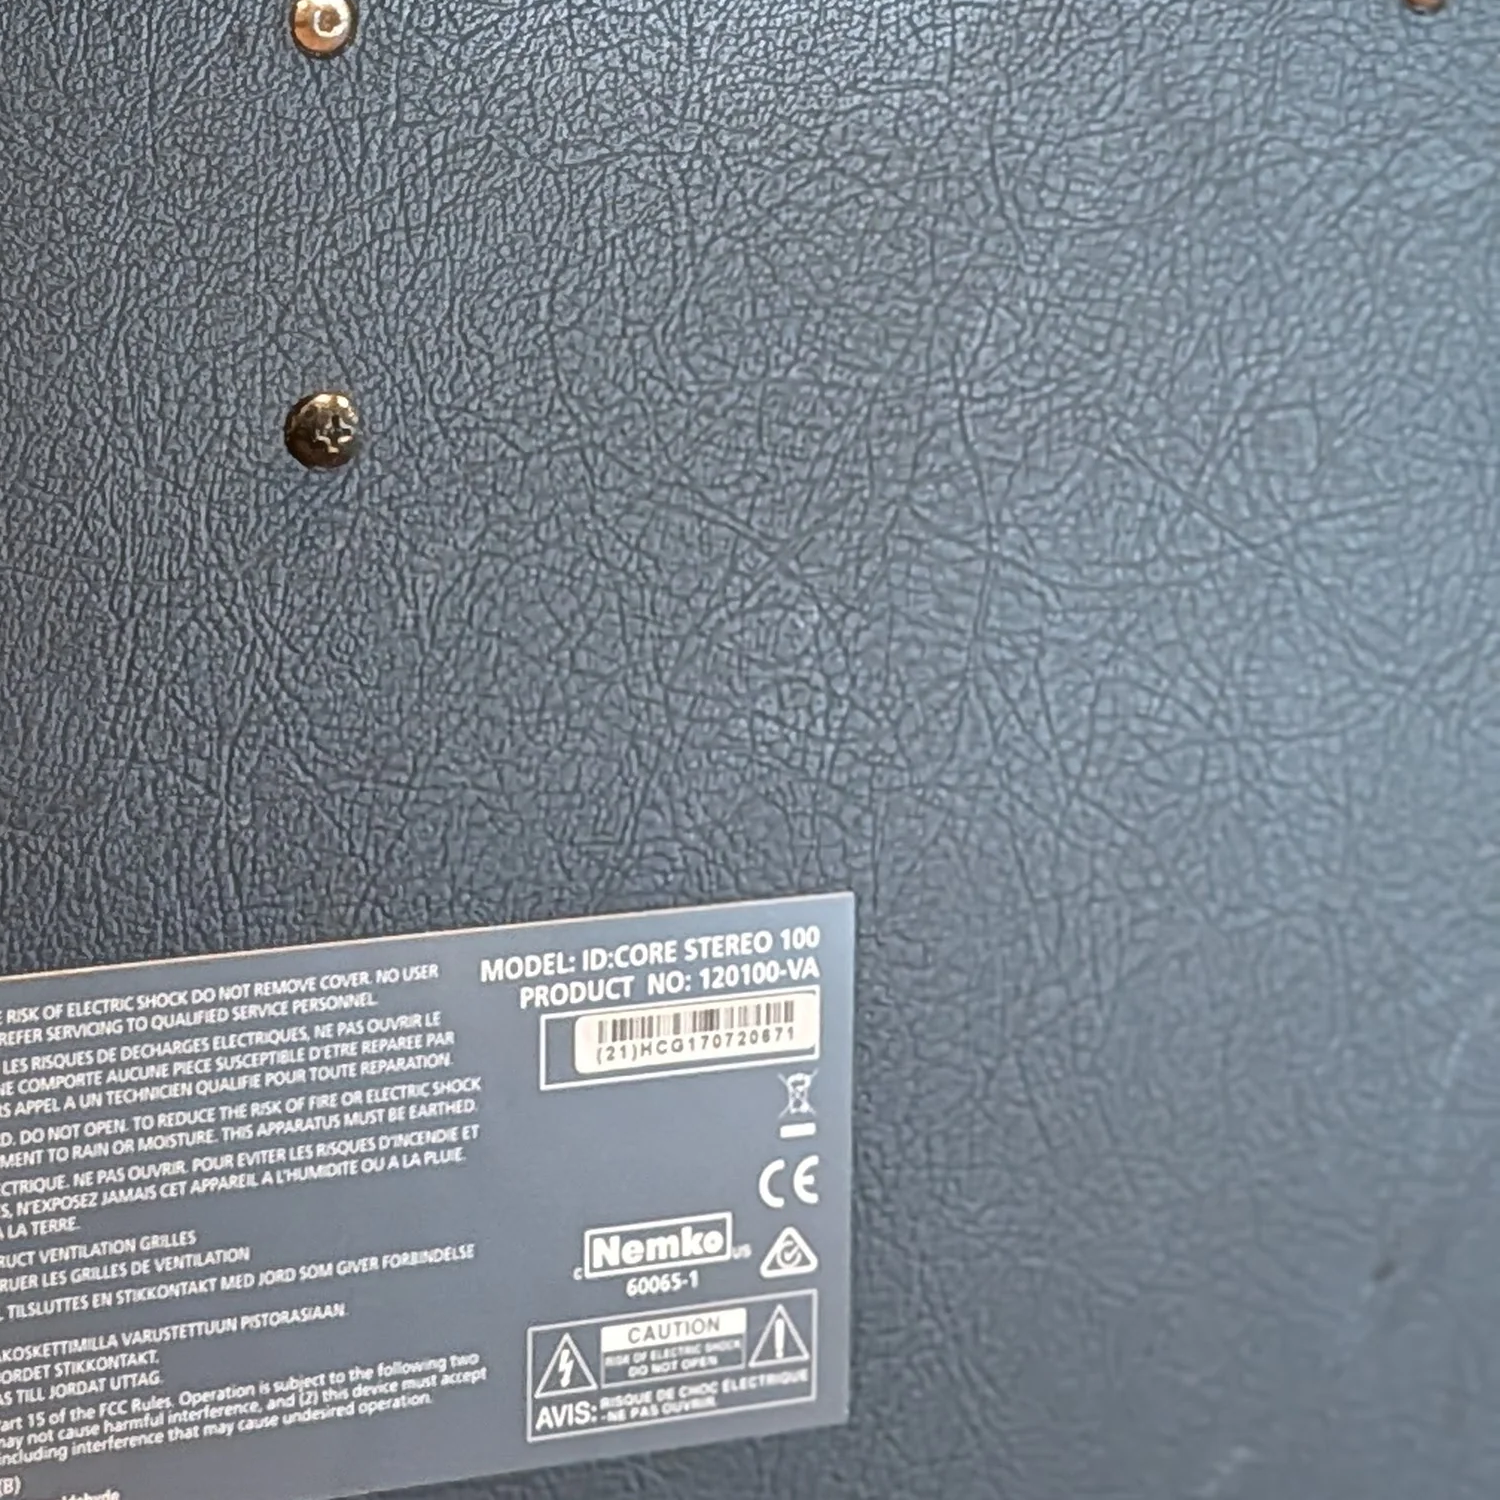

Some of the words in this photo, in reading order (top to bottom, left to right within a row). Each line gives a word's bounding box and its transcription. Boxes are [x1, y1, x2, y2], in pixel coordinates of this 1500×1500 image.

[480, 953, 576, 983] MODEL:
[582, 940, 677, 972] ID:CORE
[684, 931, 773, 961] STEREO
[781, 925, 820, 951] 100
[6, 1006, 39, 1023] RISK
[42, 1003, 63, 1020] OF
[67, 995, 134, 1017] ELECTRIC
[136, 990, 188, 1010] SHOCK
[191, 987, 216, 1004] DO
[218, 983, 250, 1000] NOT
[253, 976, 316, 996] REMOVE
[319, 971, 372, 990] COVER.
[375, 967, 399, 983] NO
[402, 963, 439, 981] USER
[519, 975, 635, 1009] PRODUCT
[647, 969, 692, 997] NO:
[700, 956, 820, 991] 120100-VA
[45, 1018, 123, 1042] SERVICING
[126, 1016, 147, 1032] TO
[150, 1007, 229, 1031] QUALIFIED
[232, 1000, 288, 1021] SERVICE
[292, 992, 378, 1014] PERSONNEL.
[19, 1127, 44, 1145] DO
[47, 1123, 81, 1140] NOT
[83, 1118, 129, 1137] OPEN.
[132, 1115, 154, 1131] TO
[157, 1107, 215, 1127] REDUCE
[218, 1103, 247, 1120] THE
[250, 1100, 281, 1117] RISK
[285, 1096, 305, 1113] OF
[308, 1092, 337, 1110] FIRE
[340, 1090, 363, 1106] OR
[366, 1082, 429, 1103] ELECTRIC
[432, 1076, 481, 1096] SHOCK
[47, 1146, 69, 1162] TO
[72, 1142, 109, 1160] RAIN
[111, 1138, 134, 1155] OR
[138, 1128, 218, 1151] MOISTURE.
[221, 1124, 253, 1141] THIS
[256, 1113, 340, 1137] APPARATUS
[343, 1108, 385, 1126] MUST
[387, 1105, 405, 1122] BE
[409, 1098, 477, 1119] EARTHED.
[7, 1223, 28, 1239] LA
[30, 1215, 81, 1235] TERRE.
[38, 1238, 135, 1264] VENTILATION
[139, 1229, 197, 1250] GRILLES
[591, 1226, 724, 1270] Nemko
[41, 1270, 67, 1287] LES
[70, 1262, 127, 1283] GRILLES
[130, 1258, 150, 1276] DE
[154, 1246, 250, 1272] VENTILATION
[625, 1269, 700, 1298] 60065-1
[627, 1316, 721, 1345] CAUTION
[16, 1387, 45, 1404] TILL
[48, 1377, 106, 1399] JORDAT
[109, 1369, 163, 1391] UTTAG.
[535, 1398, 599, 1431] AVIS:
